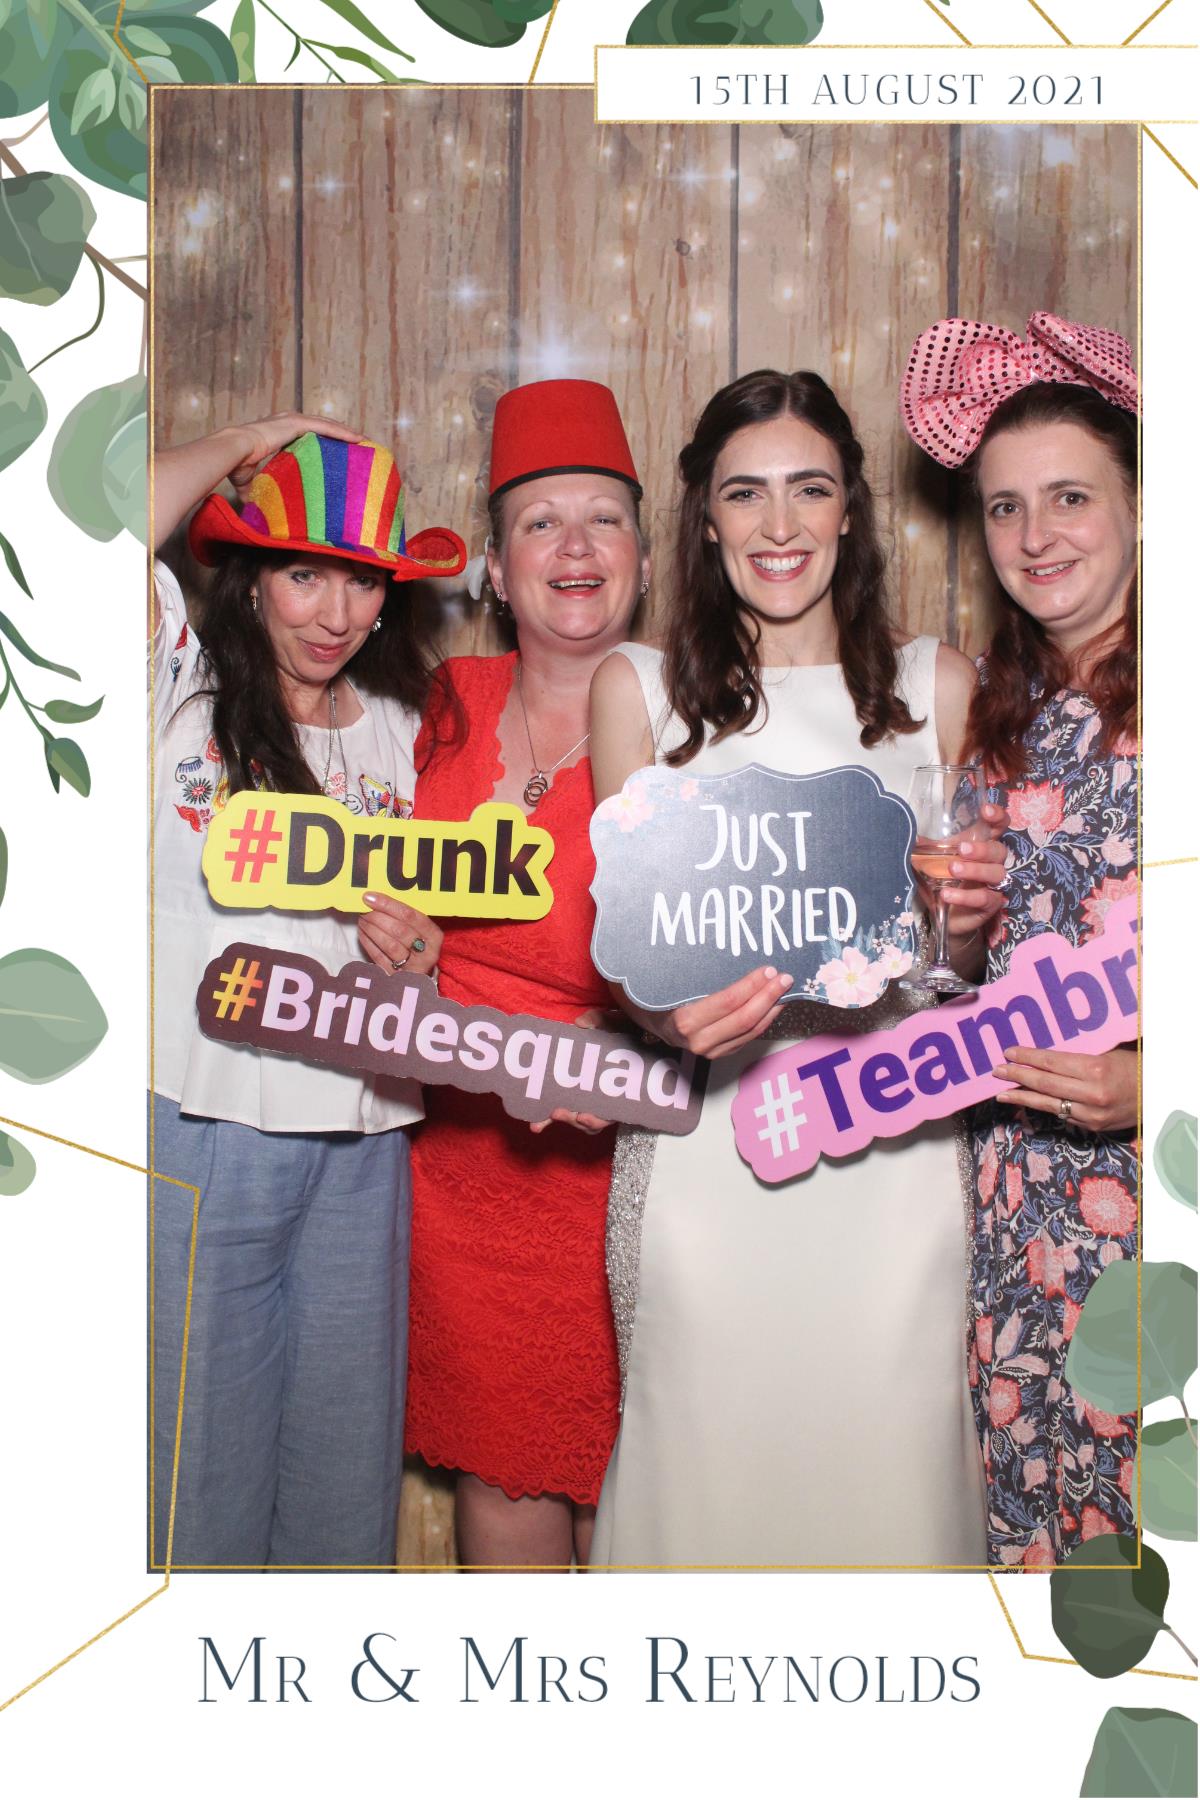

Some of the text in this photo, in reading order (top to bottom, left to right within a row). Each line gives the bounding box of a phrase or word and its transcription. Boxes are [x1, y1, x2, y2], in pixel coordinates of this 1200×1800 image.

[223, 808, 542, 897] #Drunk
[694, 804, 812, 877] JUST
[650, 884, 857, 957] MARRIED
[212, 957, 697, 1111] #Bridesquad
